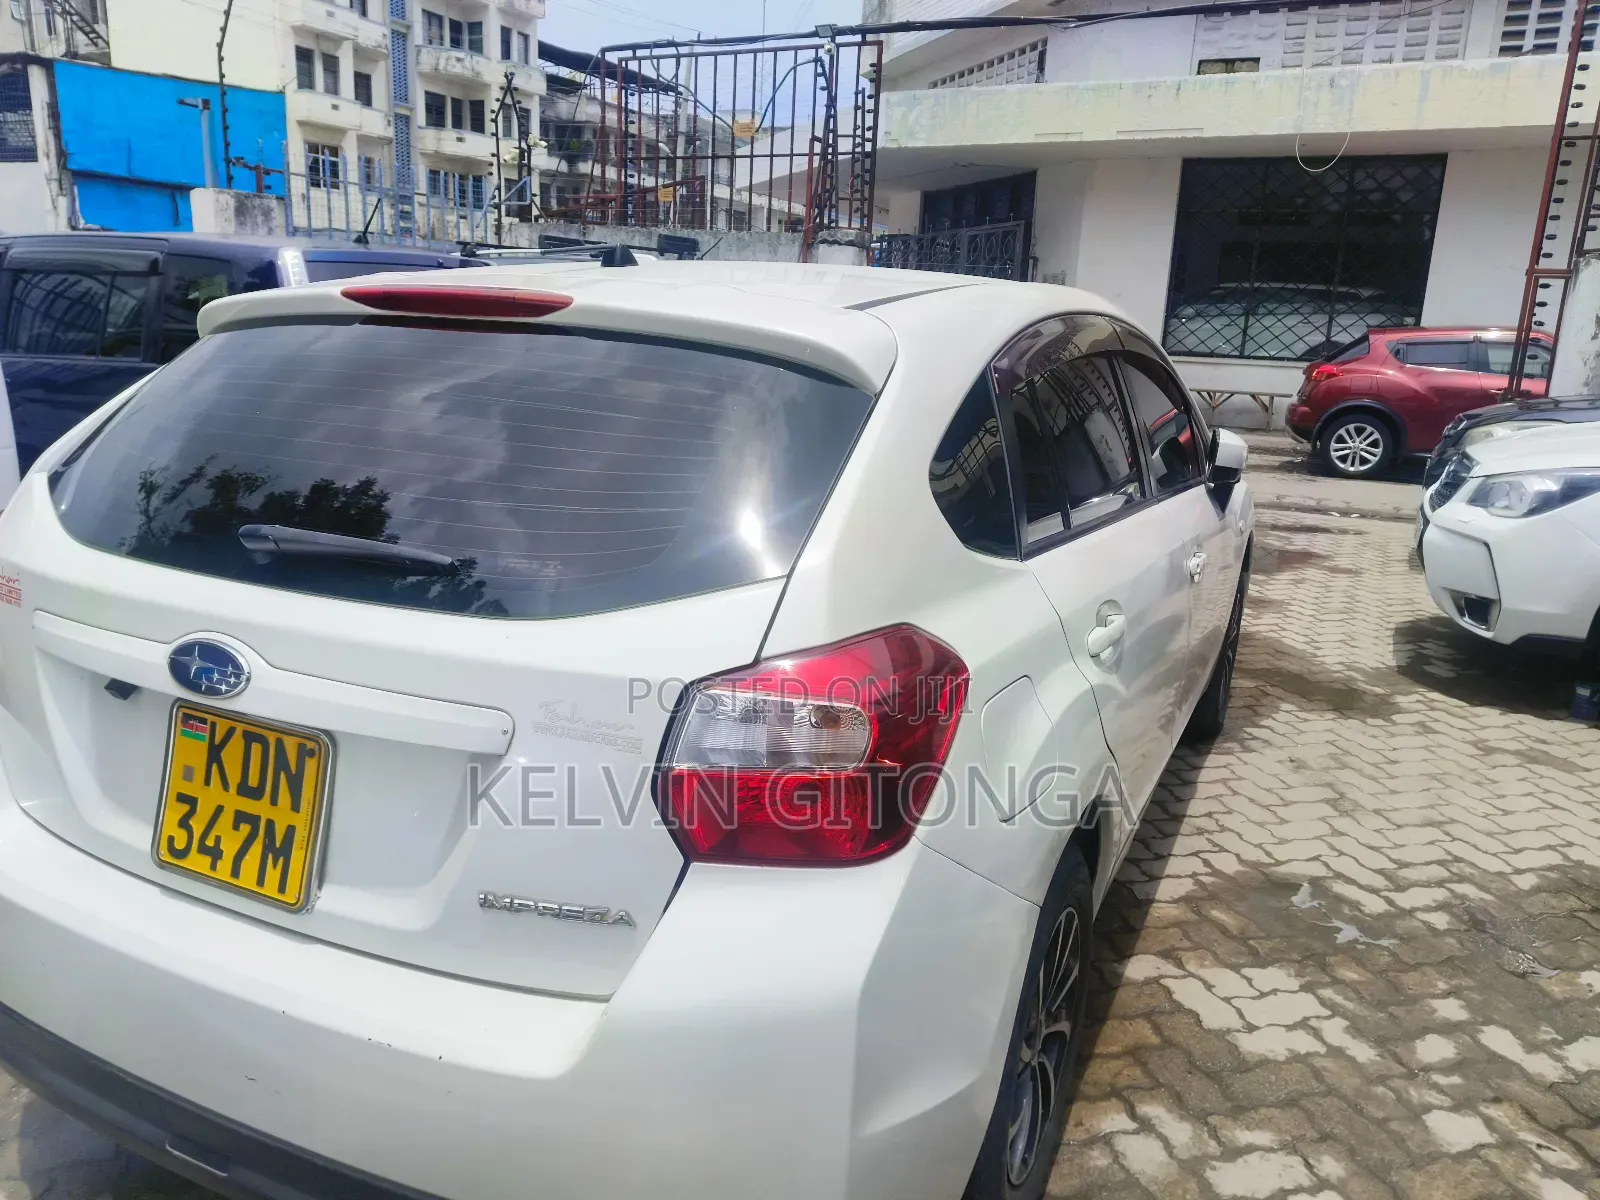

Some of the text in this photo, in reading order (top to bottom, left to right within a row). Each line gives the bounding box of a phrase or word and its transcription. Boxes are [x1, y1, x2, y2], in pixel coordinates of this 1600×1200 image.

[204, 721, 307, 814] KDN
[167, 791, 296, 895] 347M
[478, 892, 637, 928] IMPREZA
